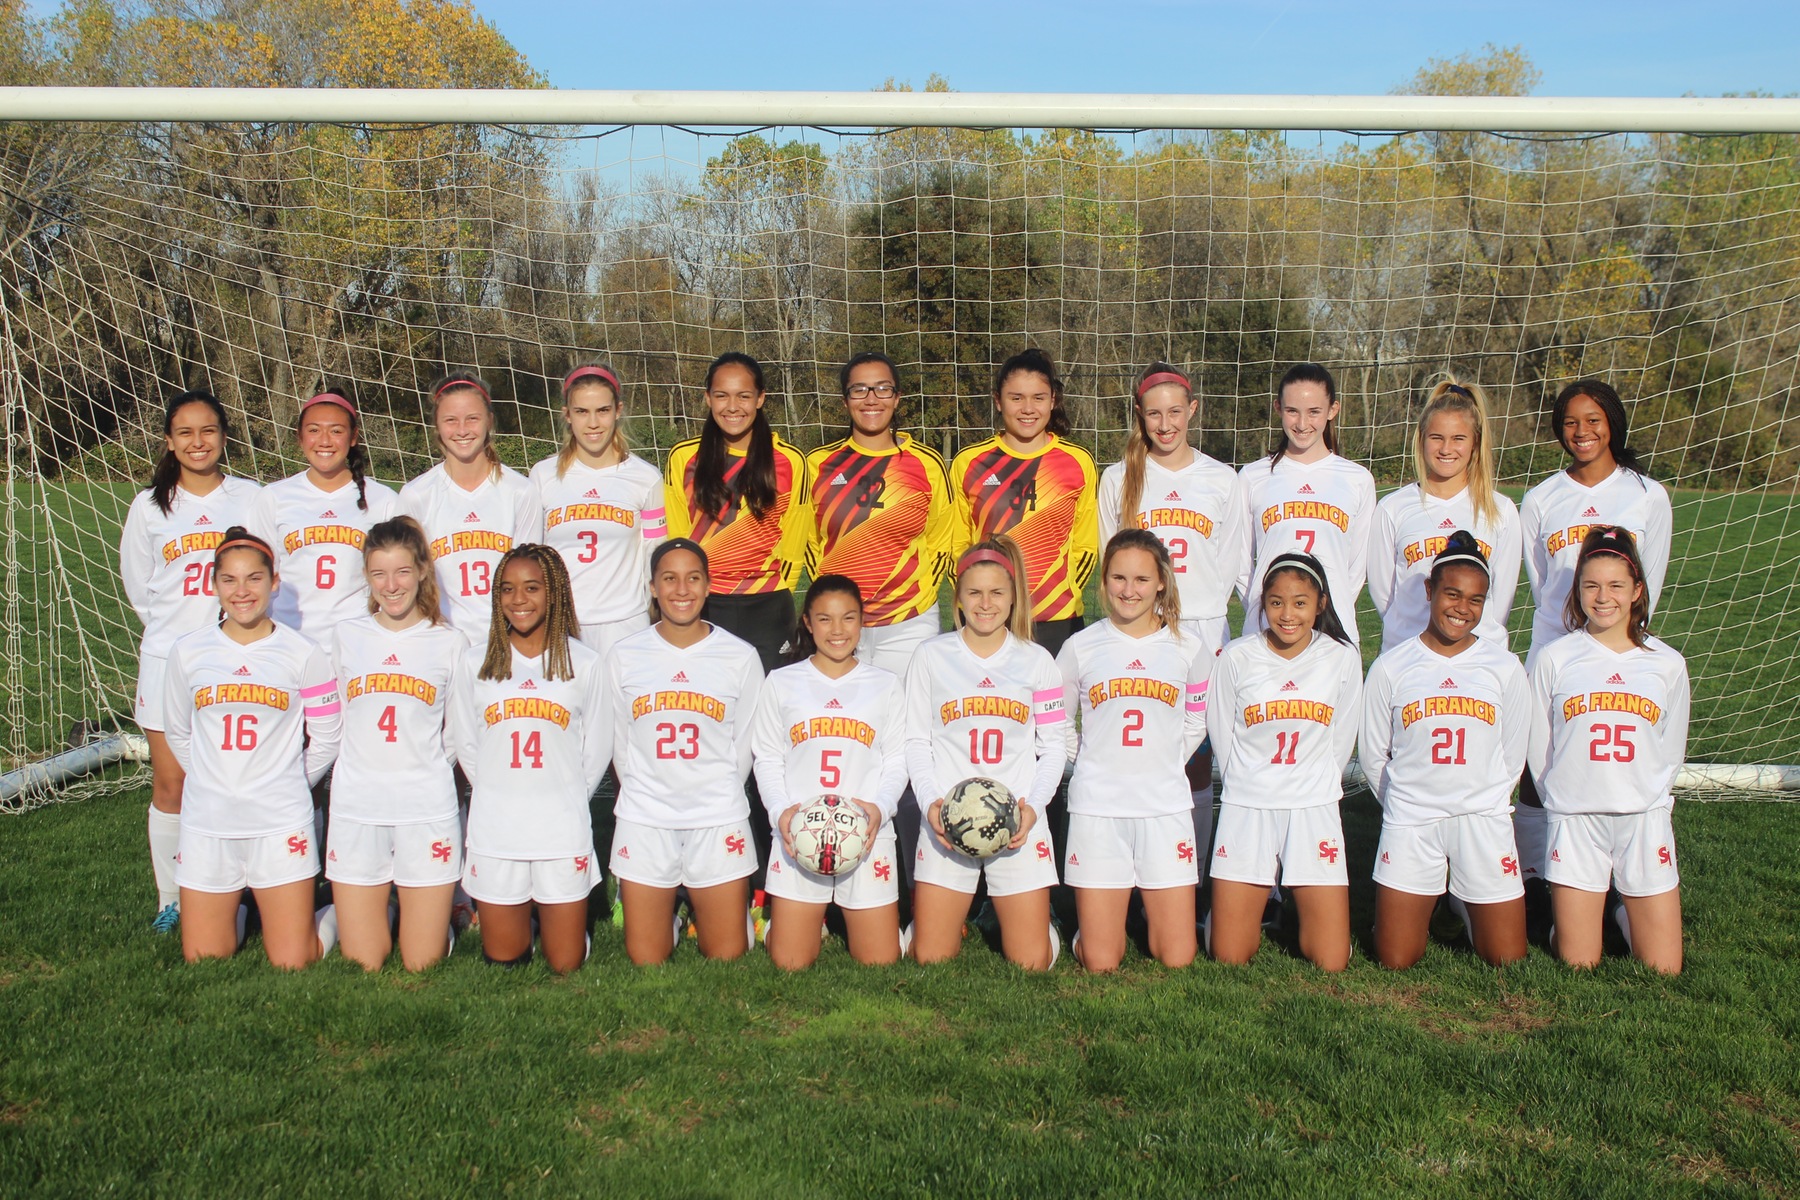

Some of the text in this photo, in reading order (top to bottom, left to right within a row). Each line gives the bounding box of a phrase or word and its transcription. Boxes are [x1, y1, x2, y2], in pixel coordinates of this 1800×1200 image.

[856, 476, 885, 508] 32
[1009, 479, 1037, 511] 34
[547, 503, 634, 531] ST. FRANCIS
[1136, 508, 1213, 539] T. FRANCIS
[1262, 501, 1349, 533] ST. FRANCIS
[162, 532, 225, 568] ST. FRAN
[284, 525, 365, 556] ST. FRANCI
[431, 536, 452, 561] ST.
[577, 531, 598, 564] 3
[1295, 530, 1316, 555] 7
[1404, 541, 1424, 569] ST.
[1547, 530, 1566, 557] ST.
[316, 555, 337, 590] 6
[459, 560, 490, 596] 13
[194, 684, 289, 711] ST. FRANCIS
[347, 673, 436, 706] ST. FRANCIS
[1089, 678, 1180, 709] ST. FRANCIS
[484, 698, 571, 731] ST. FRANCIS
[633, 691, 726, 723] ST. FRANCIS
[940, 696, 1030, 726] ST. FRANCIS
[1244, 700, 1335, 728] ST. FRANCIS
[1402, 696, 1495, 730] ST. FRANCIS
[1563, 692, 1661, 726] ST. FRANCIS
[221, 714, 258, 750] 16
[377, 706, 397, 742] 4
[789, 717, 876, 749] ST. FRANCIS
[1122, 709, 1144, 747] 2
[510, 731, 543, 768] 14
[656, 723, 699, 759] 23
[969, 728, 1004, 765] 10
[1271, 731, 1300, 765] 11
[1432, 728, 1466, 765] 21
[1589, 723, 1636, 763] 25
[820, 750, 842, 788] 5
[806, 811, 855, 827] SELECT
